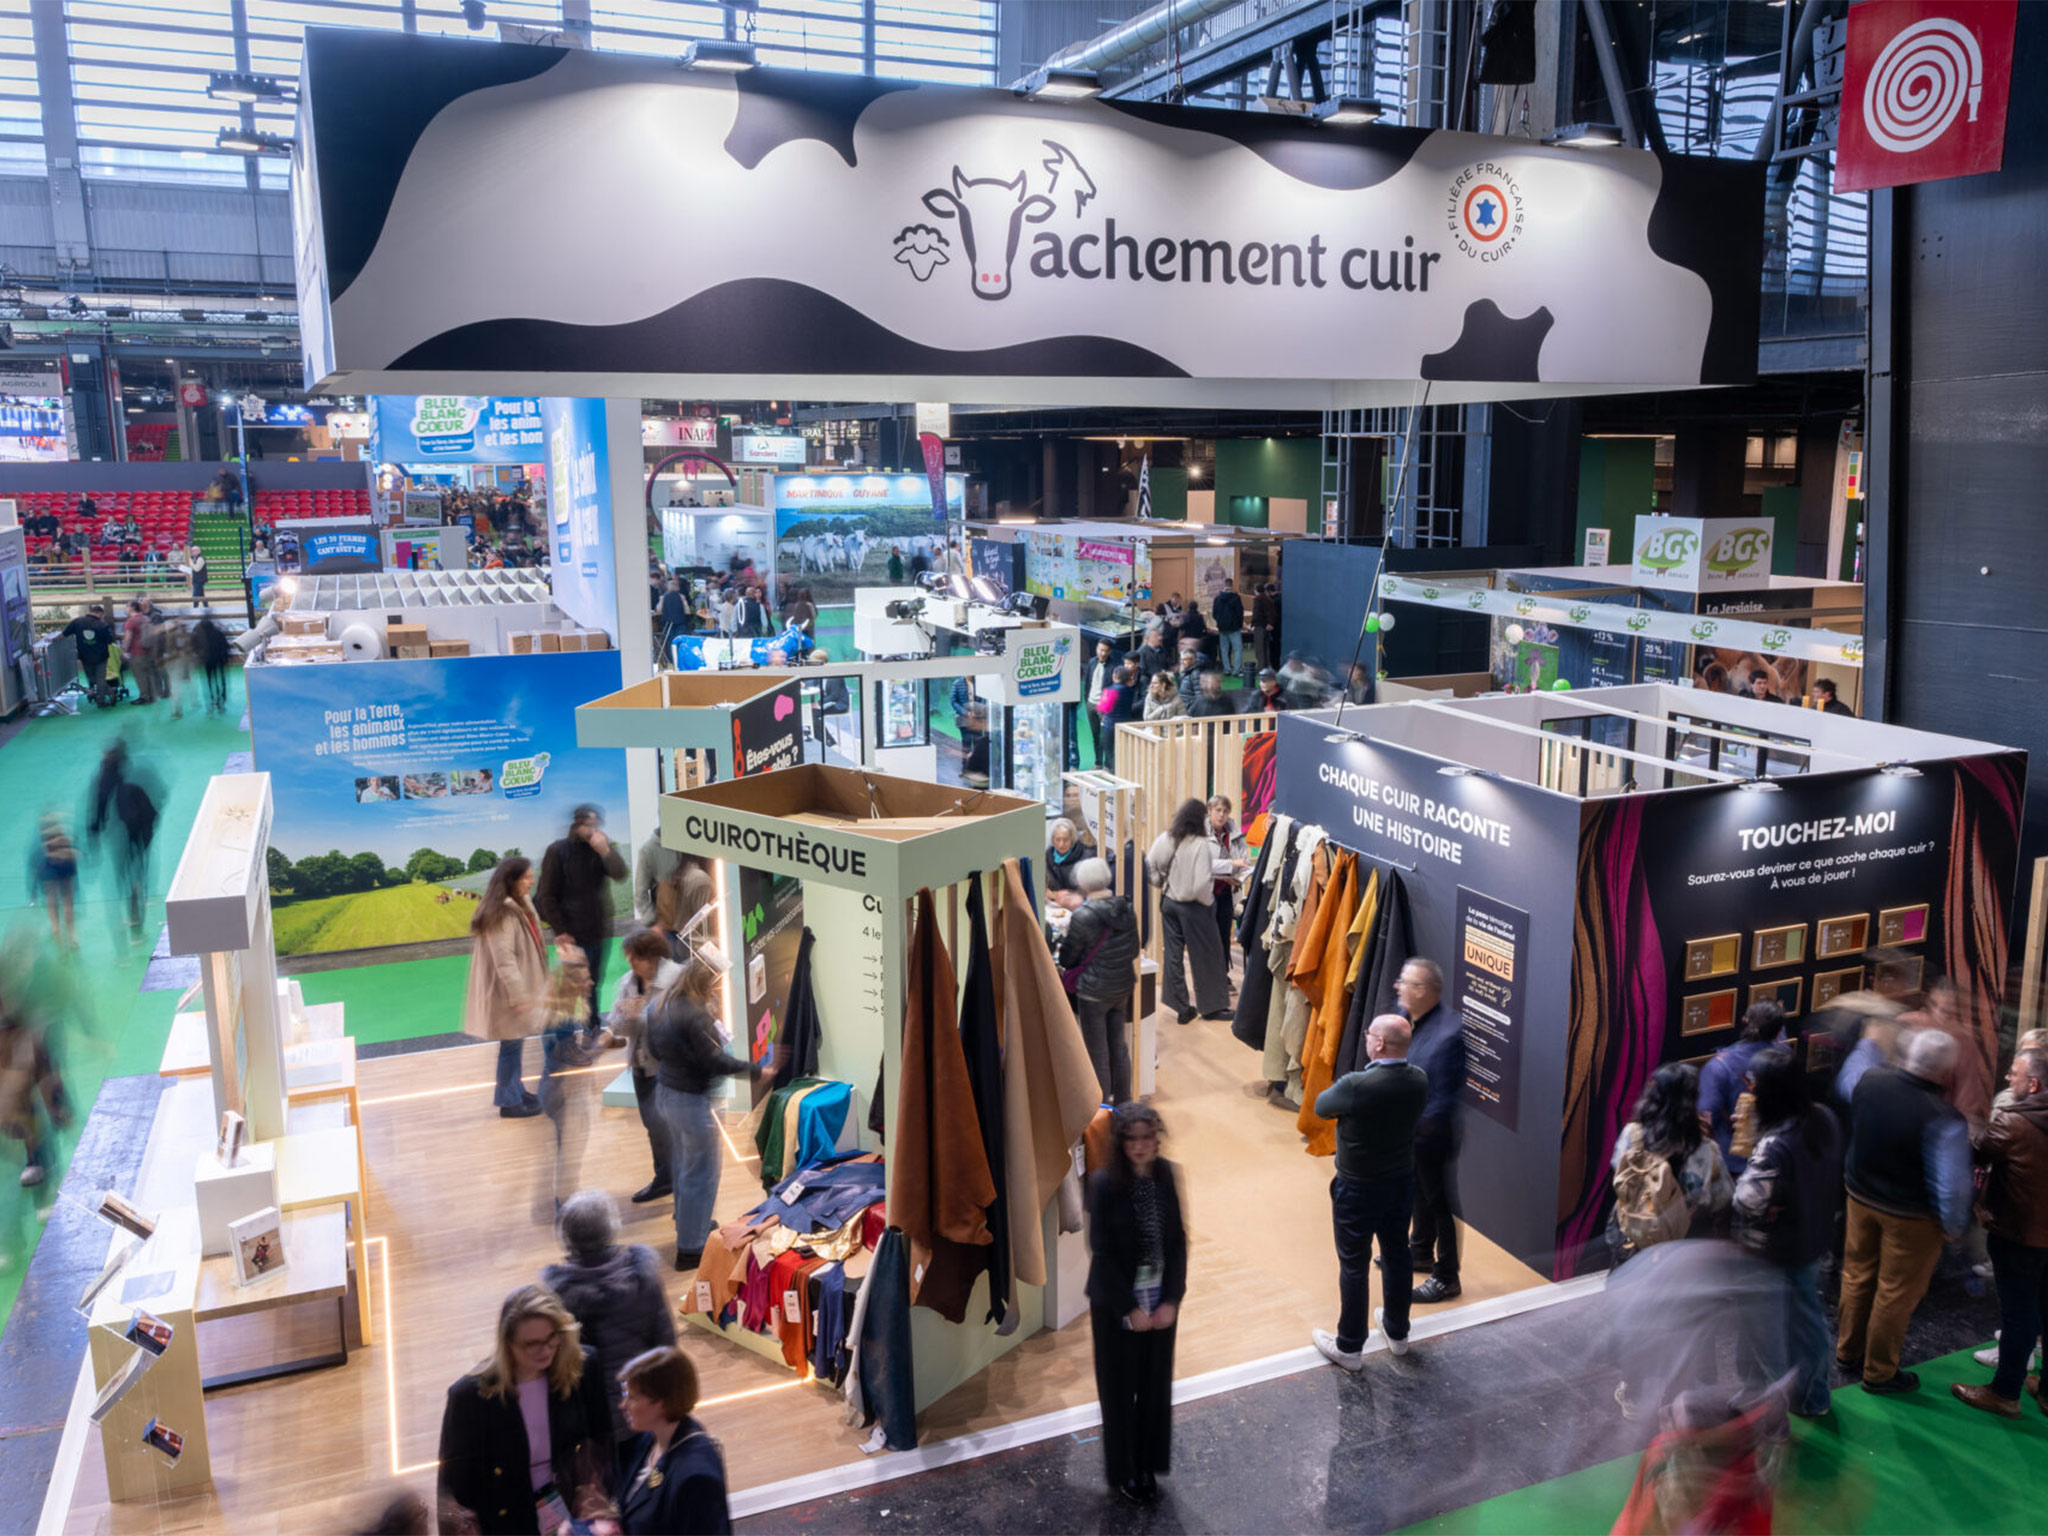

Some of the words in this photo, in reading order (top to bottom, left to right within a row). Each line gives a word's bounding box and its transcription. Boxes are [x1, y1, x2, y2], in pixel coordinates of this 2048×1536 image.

[1448, 168, 1474, 231] FILIÈRE
[1476, 162, 1524, 236] FRANÇAISE
[1458, 239, 1477, 259] DU
[1481, 241, 1512, 263] CUIR
[1339, 235, 1440, 292] cuir
[420, 408, 466, 420] BLANC
[424, 398, 458, 409] BLEU
[510, 416, 542, 429] anim
[853, 489, 888, 498] GUYANE
[1648, 533, 1697, 560] BGS
[1716, 533, 1769, 562] BGS
[1706, 604, 1719, 615] La
[1767, 630, 1792, 644] BGS
[1845, 641, 1863, 655] BG
[1020, 654, 1055, 667] BLANC
[1023, 645, 1049, 657] BLEU
[324, 709, 352, 725] Pour
[355, 707, 367, 721] la
[368, 703, 404, 719] Terre,
[330, 724, 349, 739] les
[352, 718, 405, 736] animaux
[315, 741, 329, 756] et
[331, 740, 350, 754] les
[352, 733, 406, 751] hommes
[746, 733, 793, 772] Êtes-vous
[505, 767, 535, 777] BLANC
[508, 760, 530, 769] BLEU
[1319, 762, 1379, 801] CHAQUE
[1382, 786, 1420, 816] CUIR
[1424, 799, 1512, 847] RACONTE
[1353, 805, 1383, 835] UNE
[1386, 818, 1462, 864] HISTOIRE
[1738, 810, 1897, 851] TOUCHEZ-MOI
[686, 815, 867, 877] CUIROTHÈQUE
[1687, 868, 1756, 886] Saurez-vous
[1757, 860, 1797, 876] deviner
[1798, 859, 1811, 870] ce
[1814, 857, 1834, 871] que
[1835, 851, 1867, 866] cache
[1868, 846, 1906, 863] chaque
[1907, 843, 1927, 855] cuir
[1929, 841, 1936, 851] ?
[1770, 876, 1779, 890] À
[1782, 876, 1805, 888] vous
[1808, 872, 1821, 884] de
[1822, 870, 1850, 885] jouer
[1851, 868, 1856, 878] !
[863, 926, 869, 936] 4
[1466, 946, 1511, 977] UNIQUE
